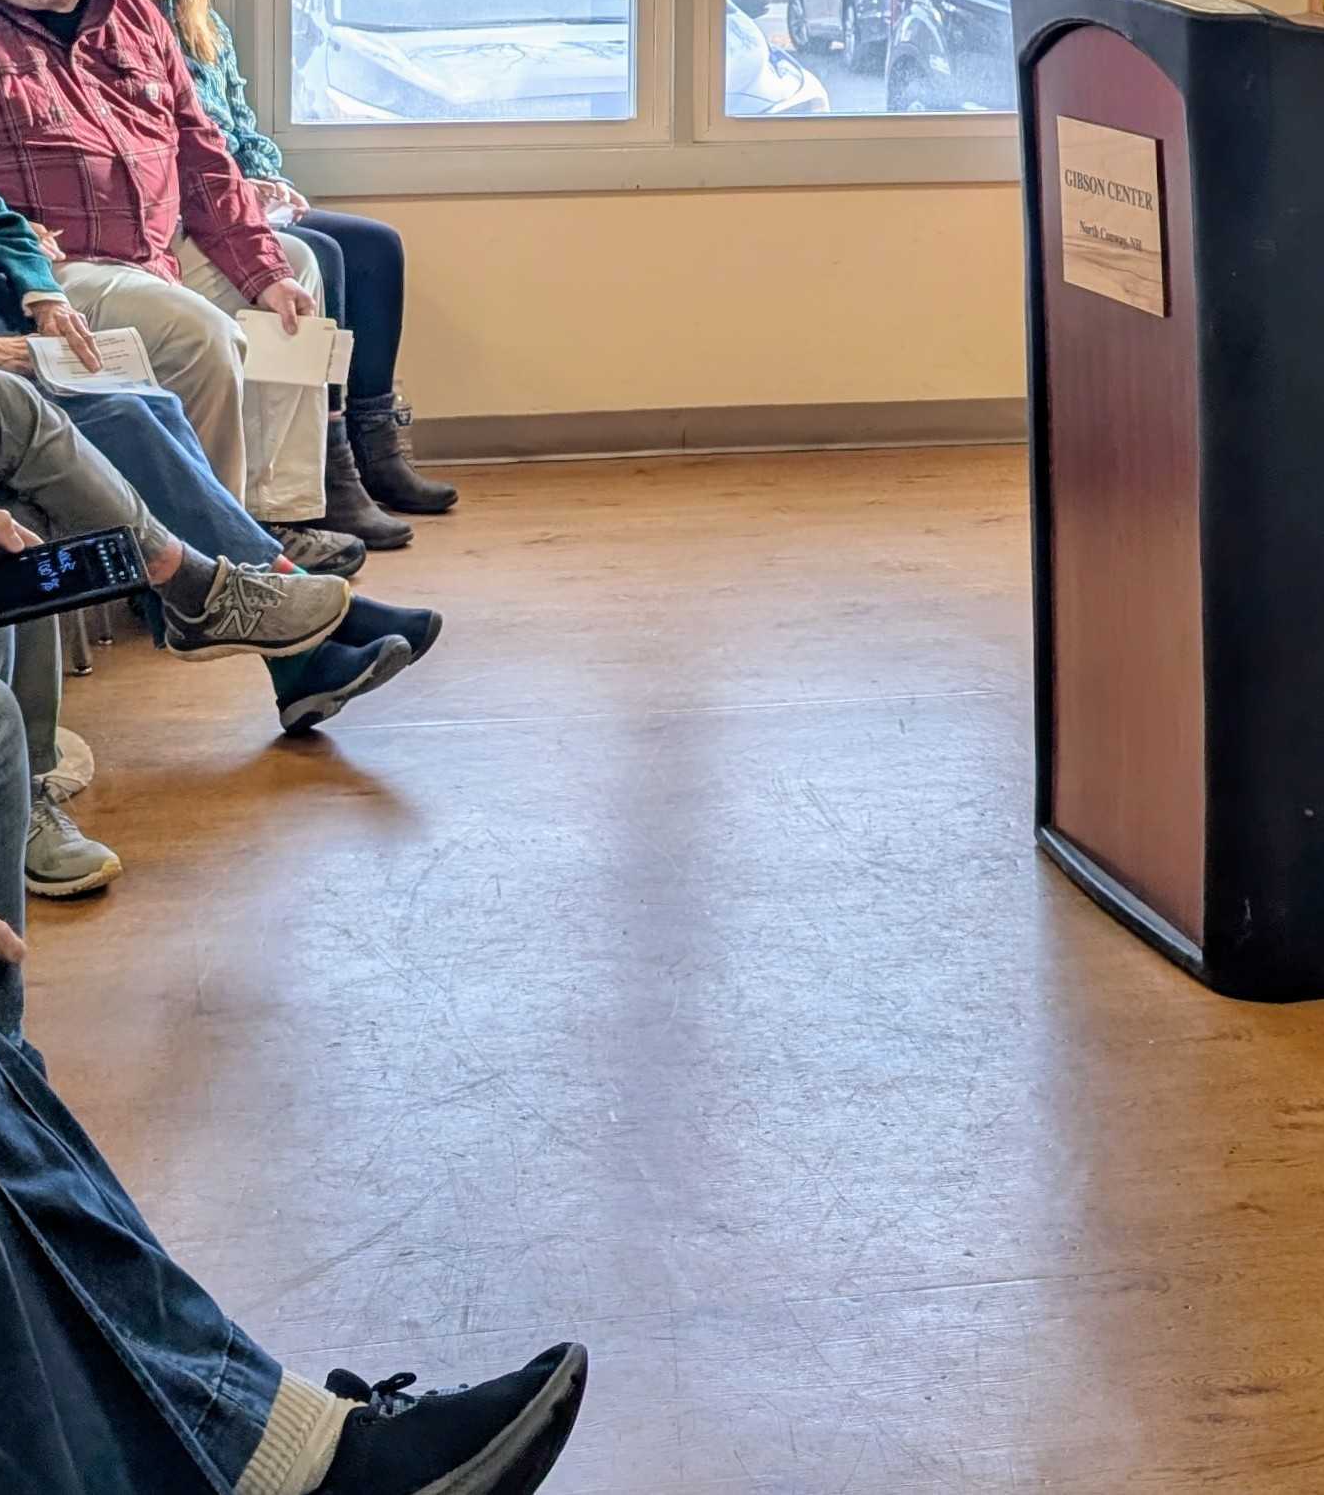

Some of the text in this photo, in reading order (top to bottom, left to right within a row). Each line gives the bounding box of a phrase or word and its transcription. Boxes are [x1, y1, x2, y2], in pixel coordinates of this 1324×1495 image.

[1064, 169, 1154, 211] GIBSON CENTER
[1079, 219, 1100, 239] North
